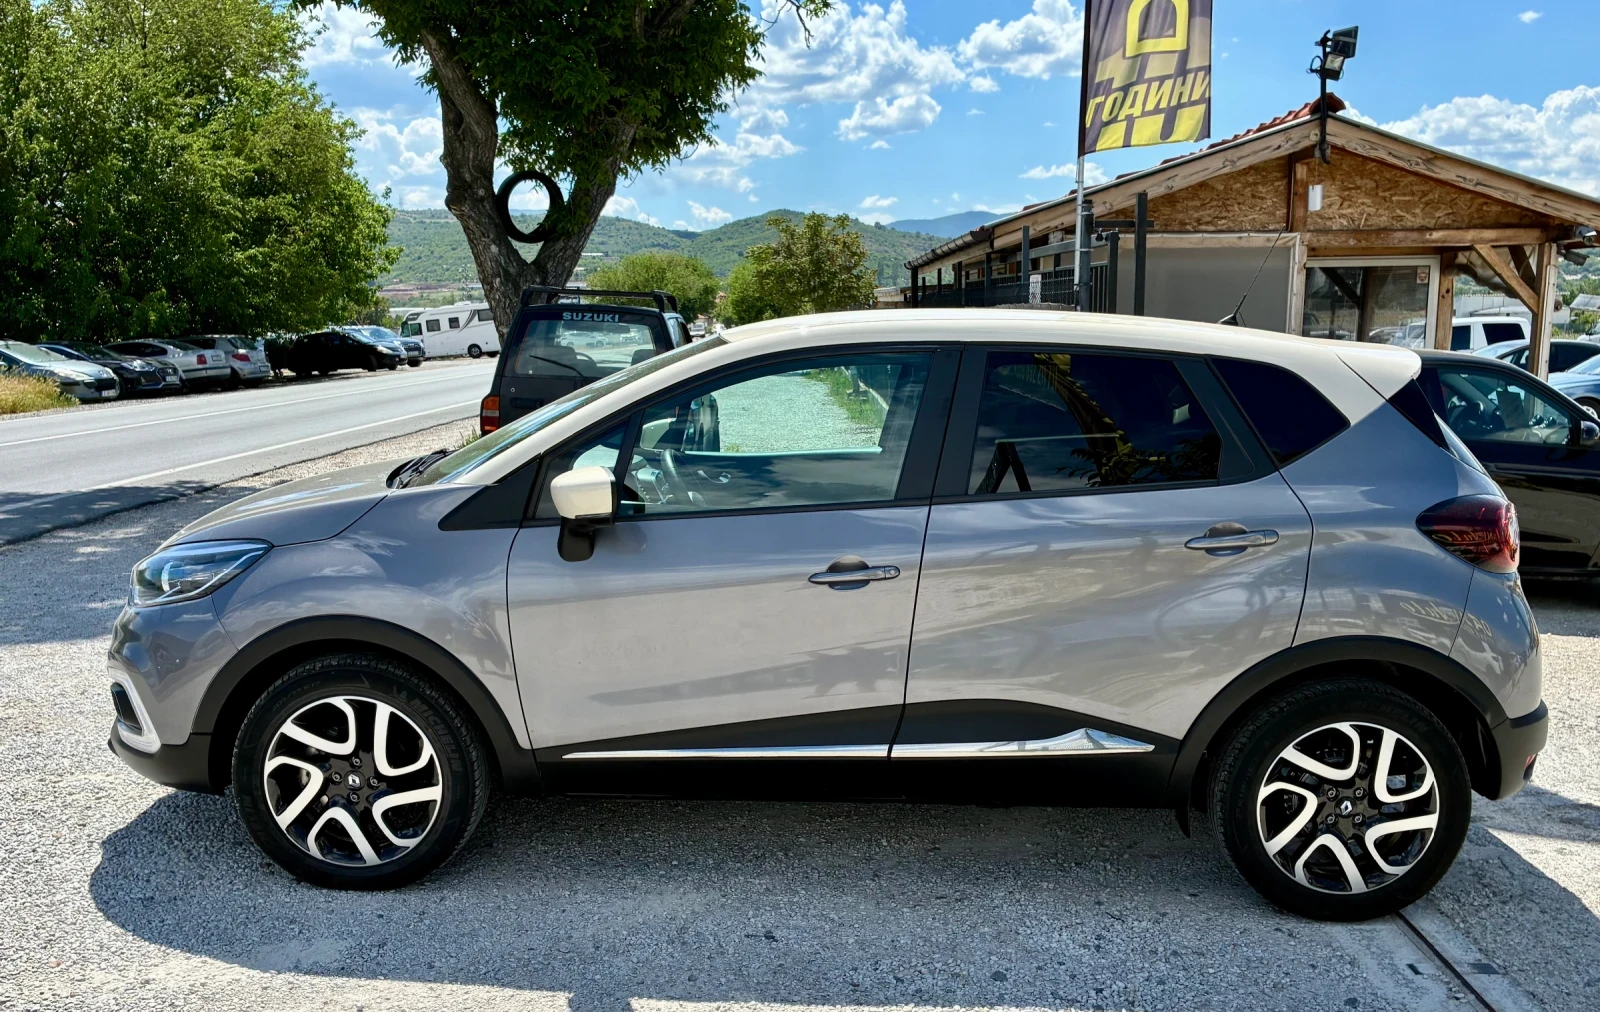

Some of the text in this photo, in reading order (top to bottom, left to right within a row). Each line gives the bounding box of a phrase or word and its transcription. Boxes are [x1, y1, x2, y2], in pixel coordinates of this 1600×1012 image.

[1085, 71, 1210, 128] ГОДИНИ
[562, 312, 619, 322] SUZUKI
[409, 698, 463, 772] MICHELIN
